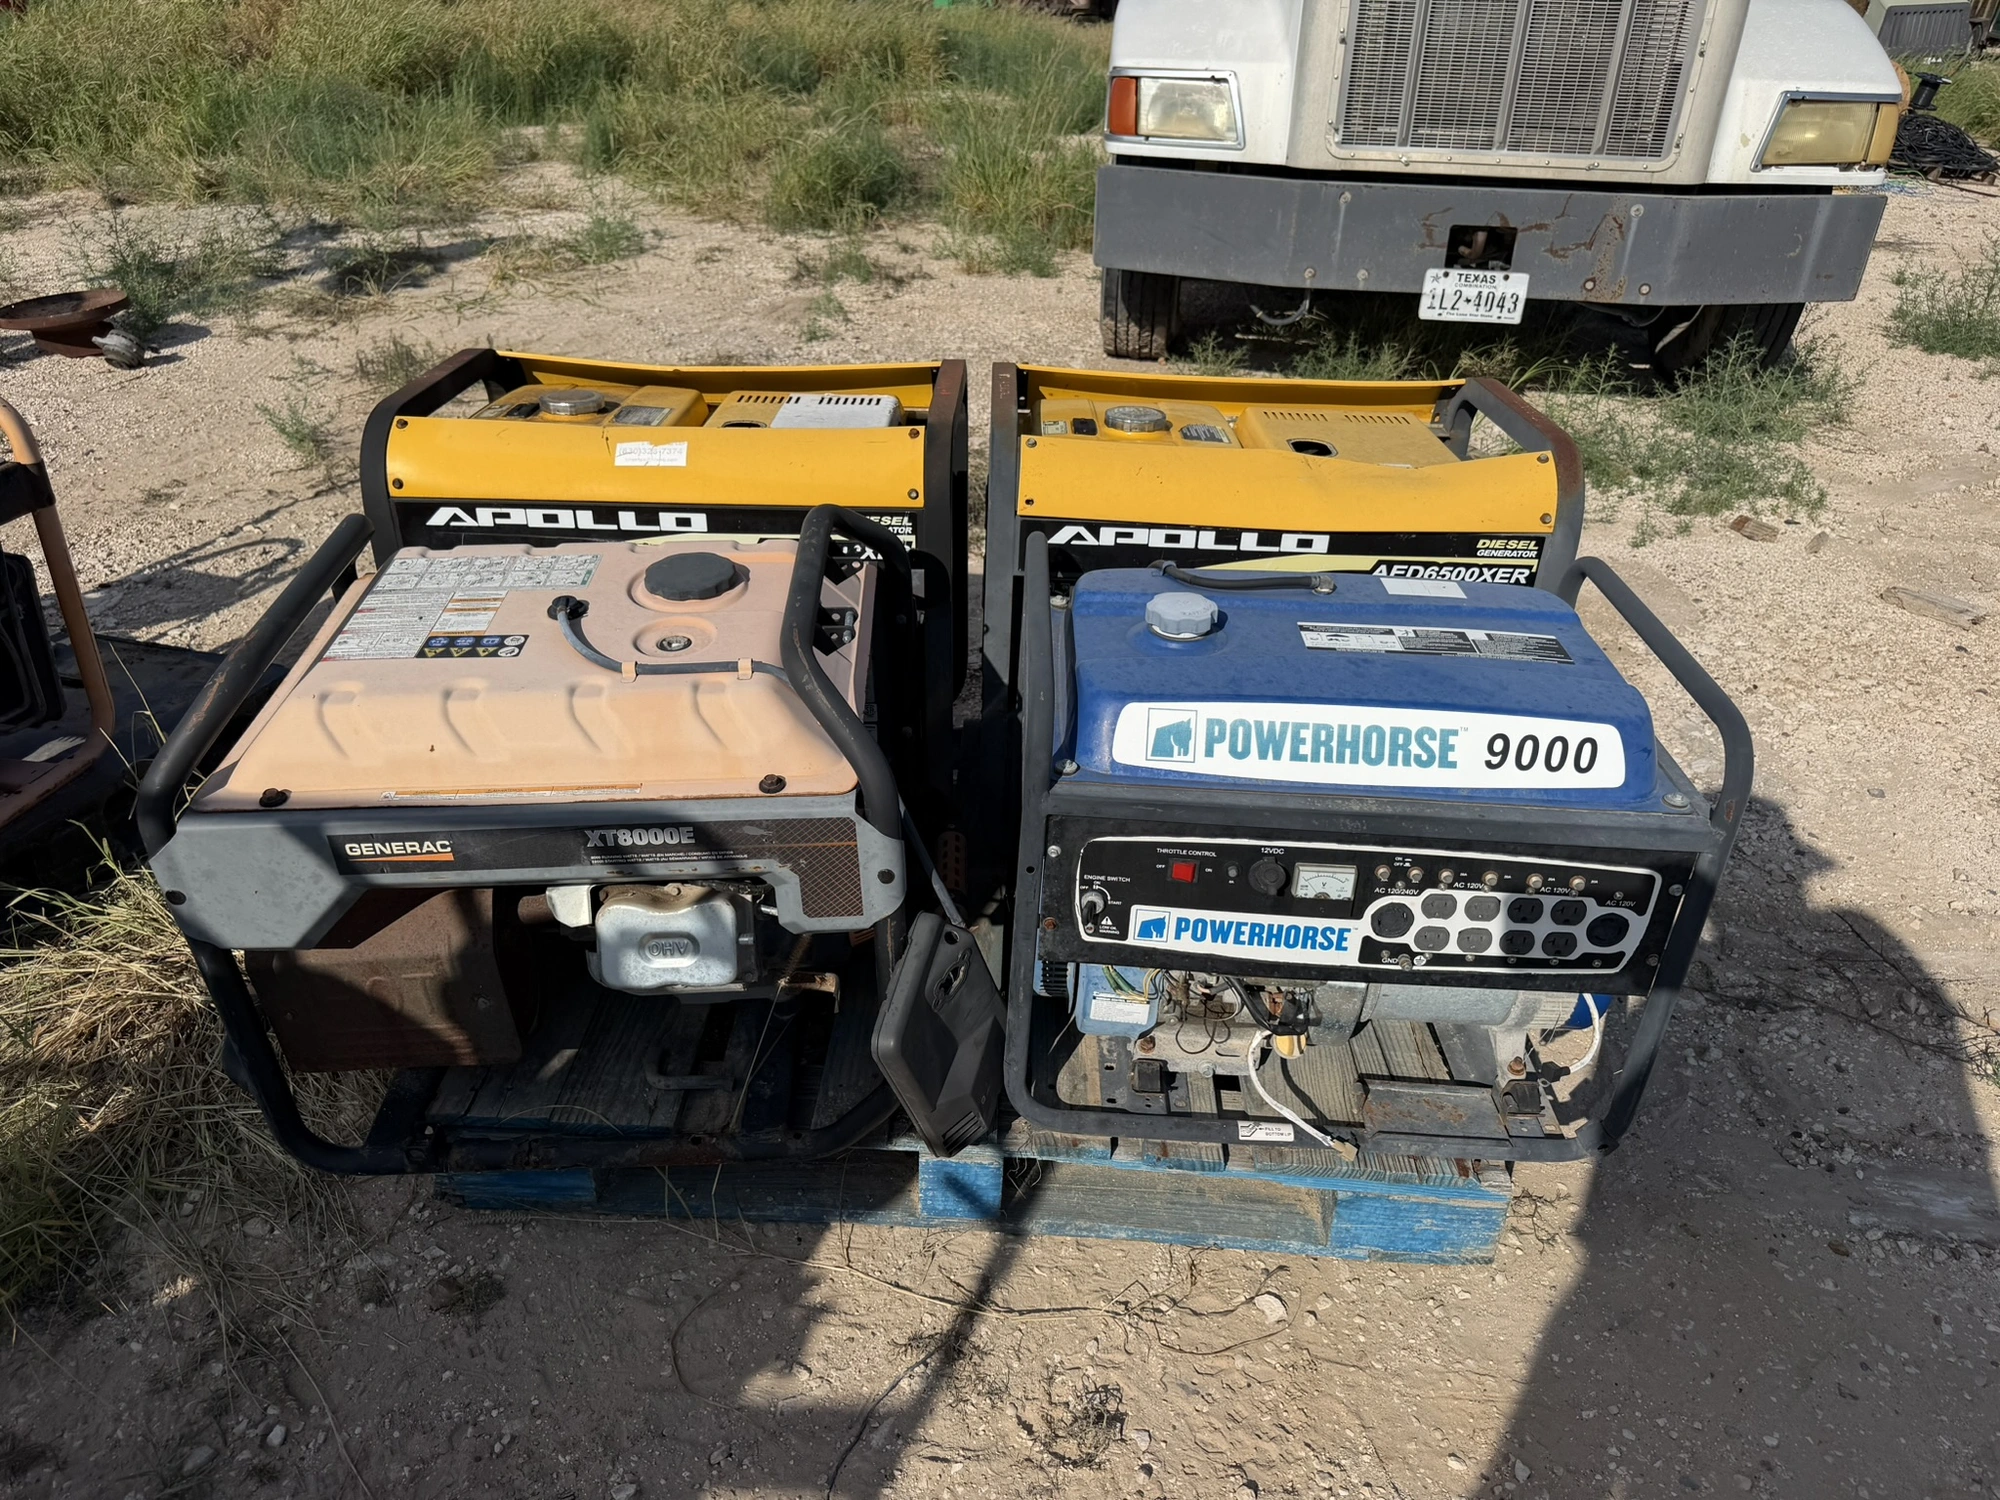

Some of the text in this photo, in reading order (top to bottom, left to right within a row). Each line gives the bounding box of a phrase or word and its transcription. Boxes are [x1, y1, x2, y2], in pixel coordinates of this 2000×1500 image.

[1457, 273, 1496, 284] TEXAS
[1473, 290, 1519, 314] 4043
[426, 507, 708, 532] APOLLO
[866, 516, 912, 526] ESEL
[1047, 525, 1330, 553] APOLLO
[1476, 539, 1538, 550] DIESEL
[1477, 550, 1537, 558] GENERATOR
[1204, 718, 1459, 769] POWERHORSE
[1484, 733, 1598, 774] 9000
[584, 826, 695, 847] XT8000E
[345, 840, 452, 856] GENERAC
[1174, 916, 1352, 952] POWERHORSE
[648, 941, 689, 956] OHV
